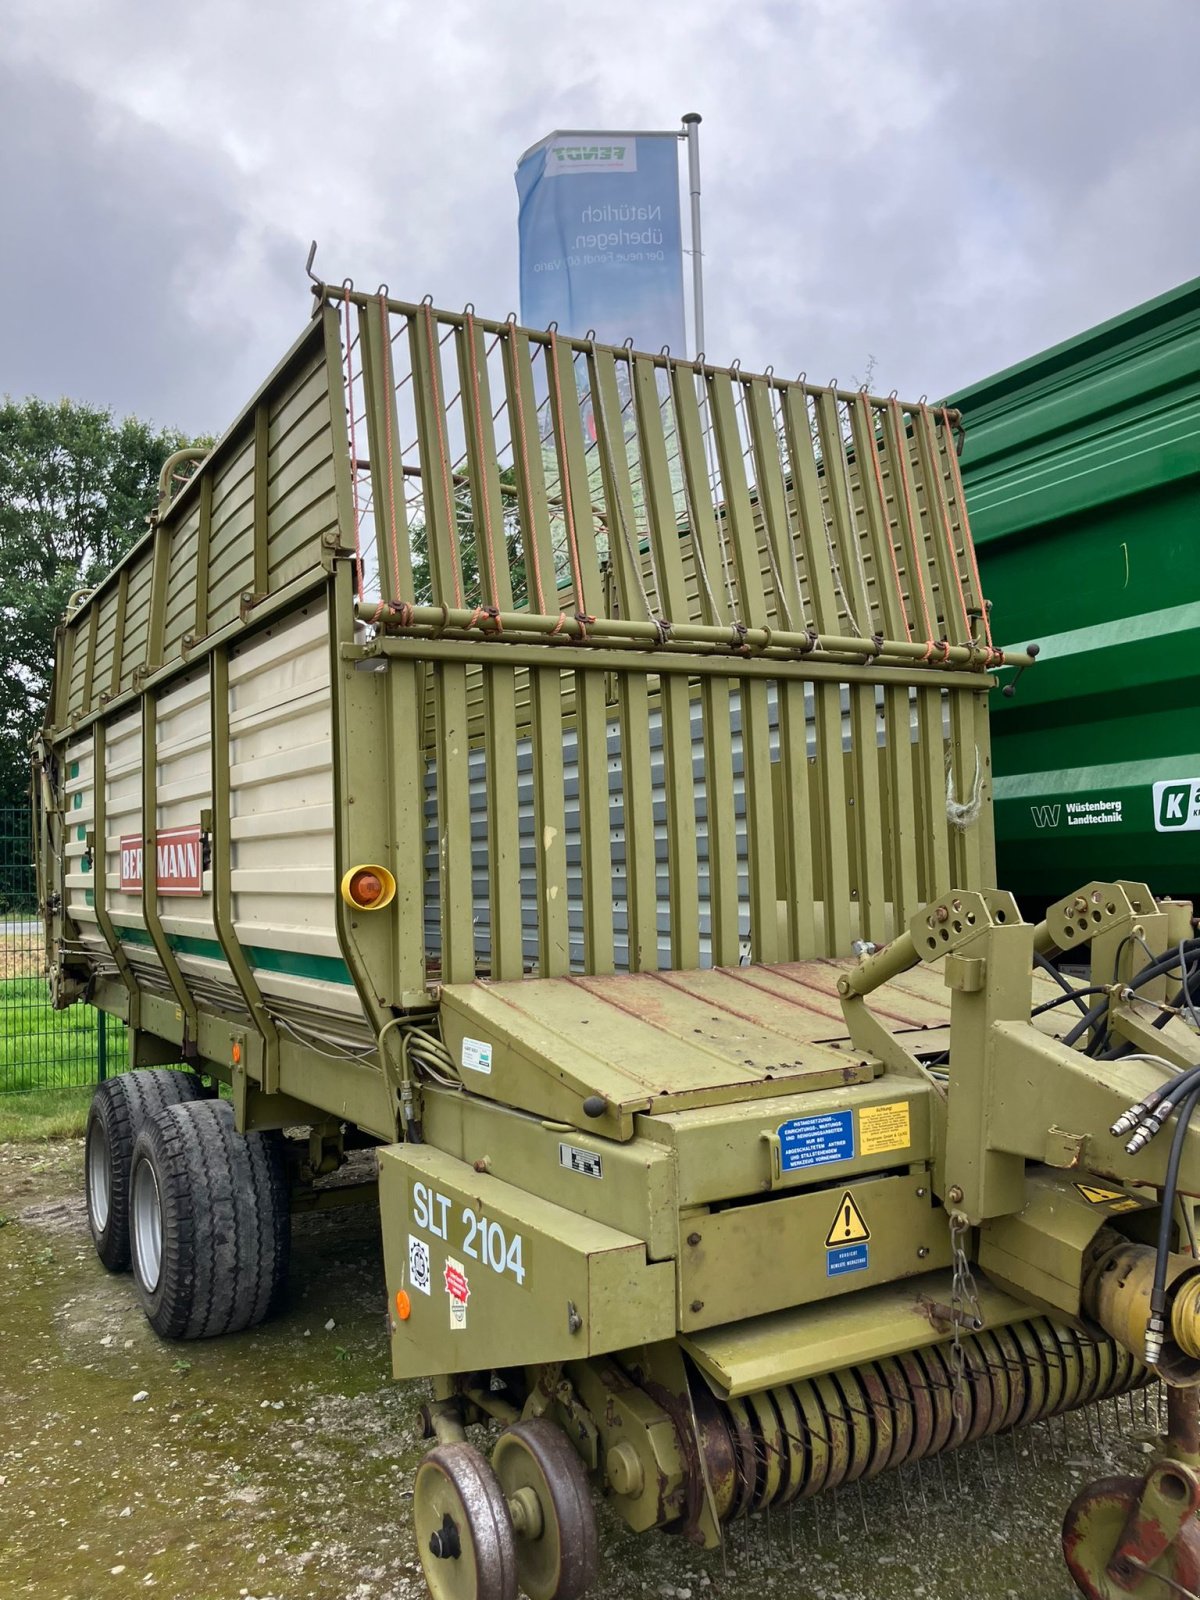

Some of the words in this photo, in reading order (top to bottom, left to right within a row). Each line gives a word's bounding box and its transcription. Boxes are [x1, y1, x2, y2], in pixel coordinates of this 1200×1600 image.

[1066, 801, 1122, 813] Wüstenberg
[1068, 812, 1122, 825] Landtechnik
[122, 842, 197, 879] BERMANN
[413, 1181, 452, 1240] SLT
[462, 1207, 526, 1286] 2104
